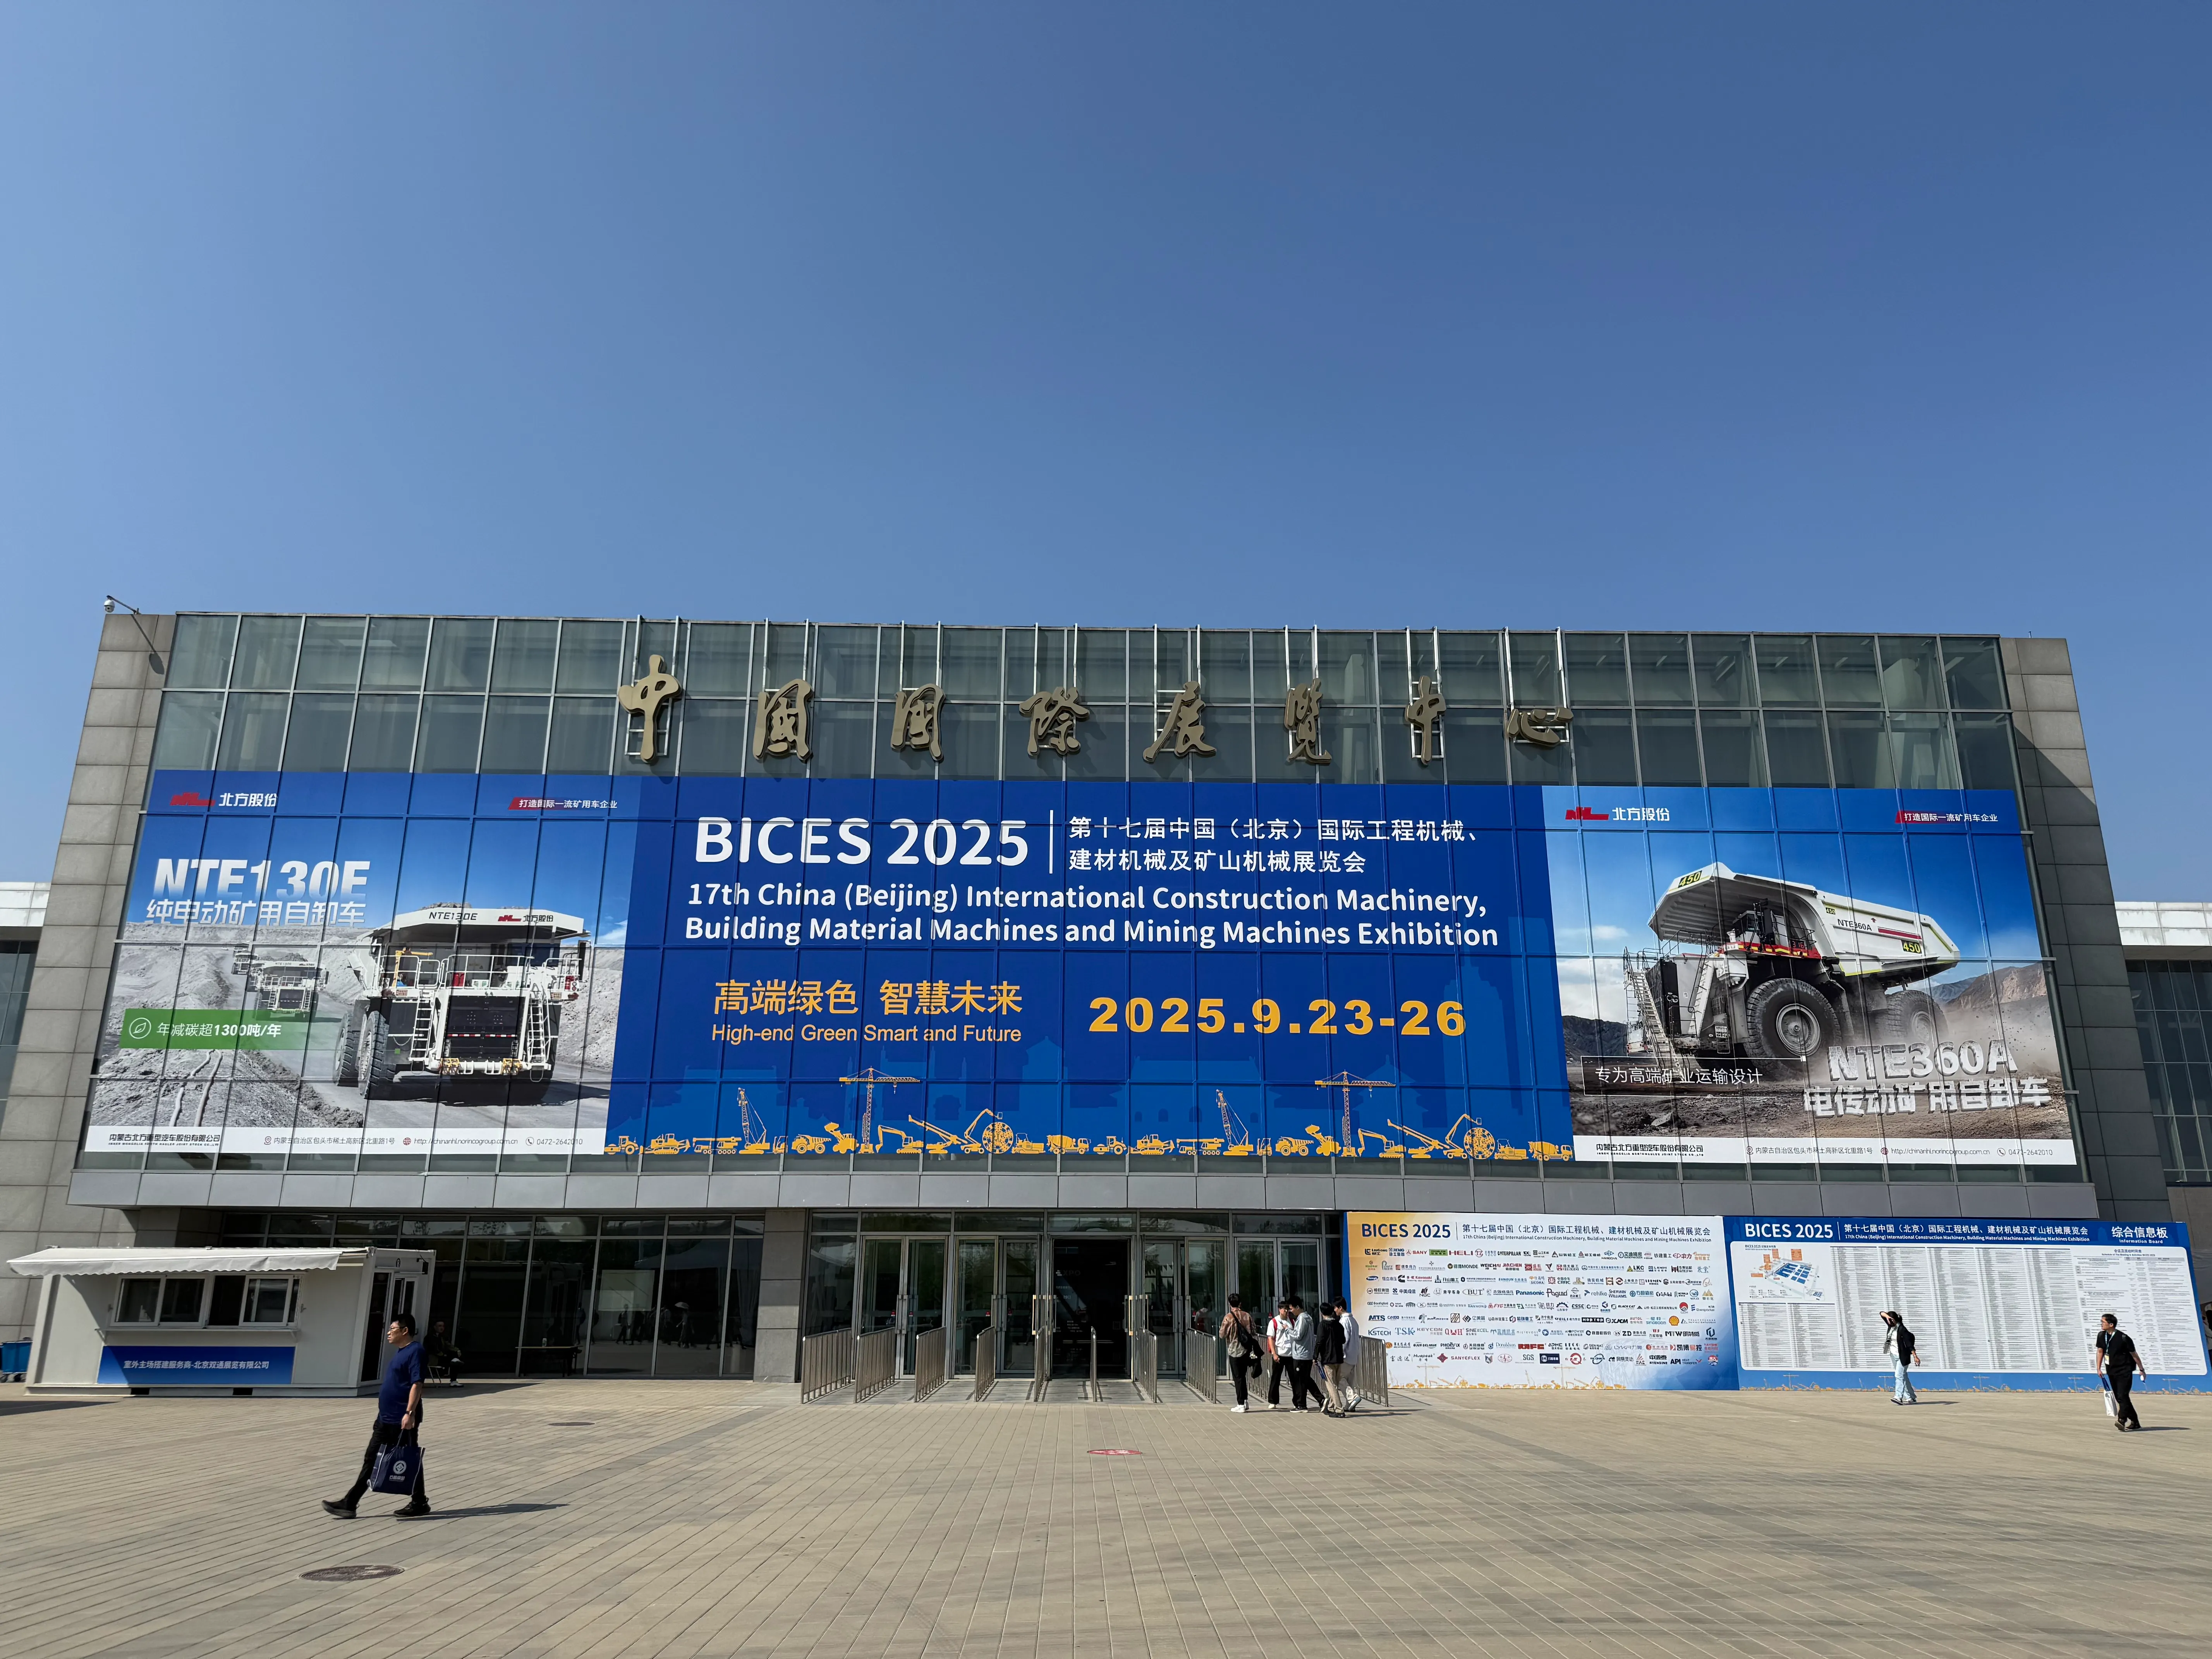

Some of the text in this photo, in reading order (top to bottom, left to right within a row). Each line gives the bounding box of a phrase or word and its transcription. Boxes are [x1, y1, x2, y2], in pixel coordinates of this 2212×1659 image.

[219, 793, 278, 807] 北方股份
[519, 799, 617, 808] 打造国际一流矿用车企业
[1612, 807, 1670, 821] 北方股份
[1904, 813, 1998, 822] 打造国际一流矿用车企业
[696, 817, 1028, 866] BICES 2025
[1069, 848, 1366, 874] 建材机械及矿山机械展览会
[153, 859, 370, 902] NTE130E
[1680, 872, 1701, 886] 450
[688, 883, 1486, 918] 17th China (Beijing) International Construction Machinery,
[144, 899, 366, 927] 纯电动矿用自卸车
[685, 917, 1498, 950] Building Material Machines and Mining Machines Exhibition
[1838, 919, 1872, 931] NTE360A
[1903, 941, 1921, 953] 450
[714, 979, 1023, 1016] 高端绿色 智慧未来
[1089, 997, 1466, 1036] 2025.9.23-26
[156, 1022, 282, 1037] 年减碳超1300吨/年
[712, 1024, 1022, 1045] High-end Green Smart and Future
[1827, 1039, 2019, 1081] NTE360A
[1595, 1066, 1763, 1085] 专为高端矿业运输设计
[1362, 1224, 1450, 1238] BICES 2025
[1745, 1224, 1833, 1238] BICES 2025
[2111, 1226, 2168, 1238] 综合信息板
